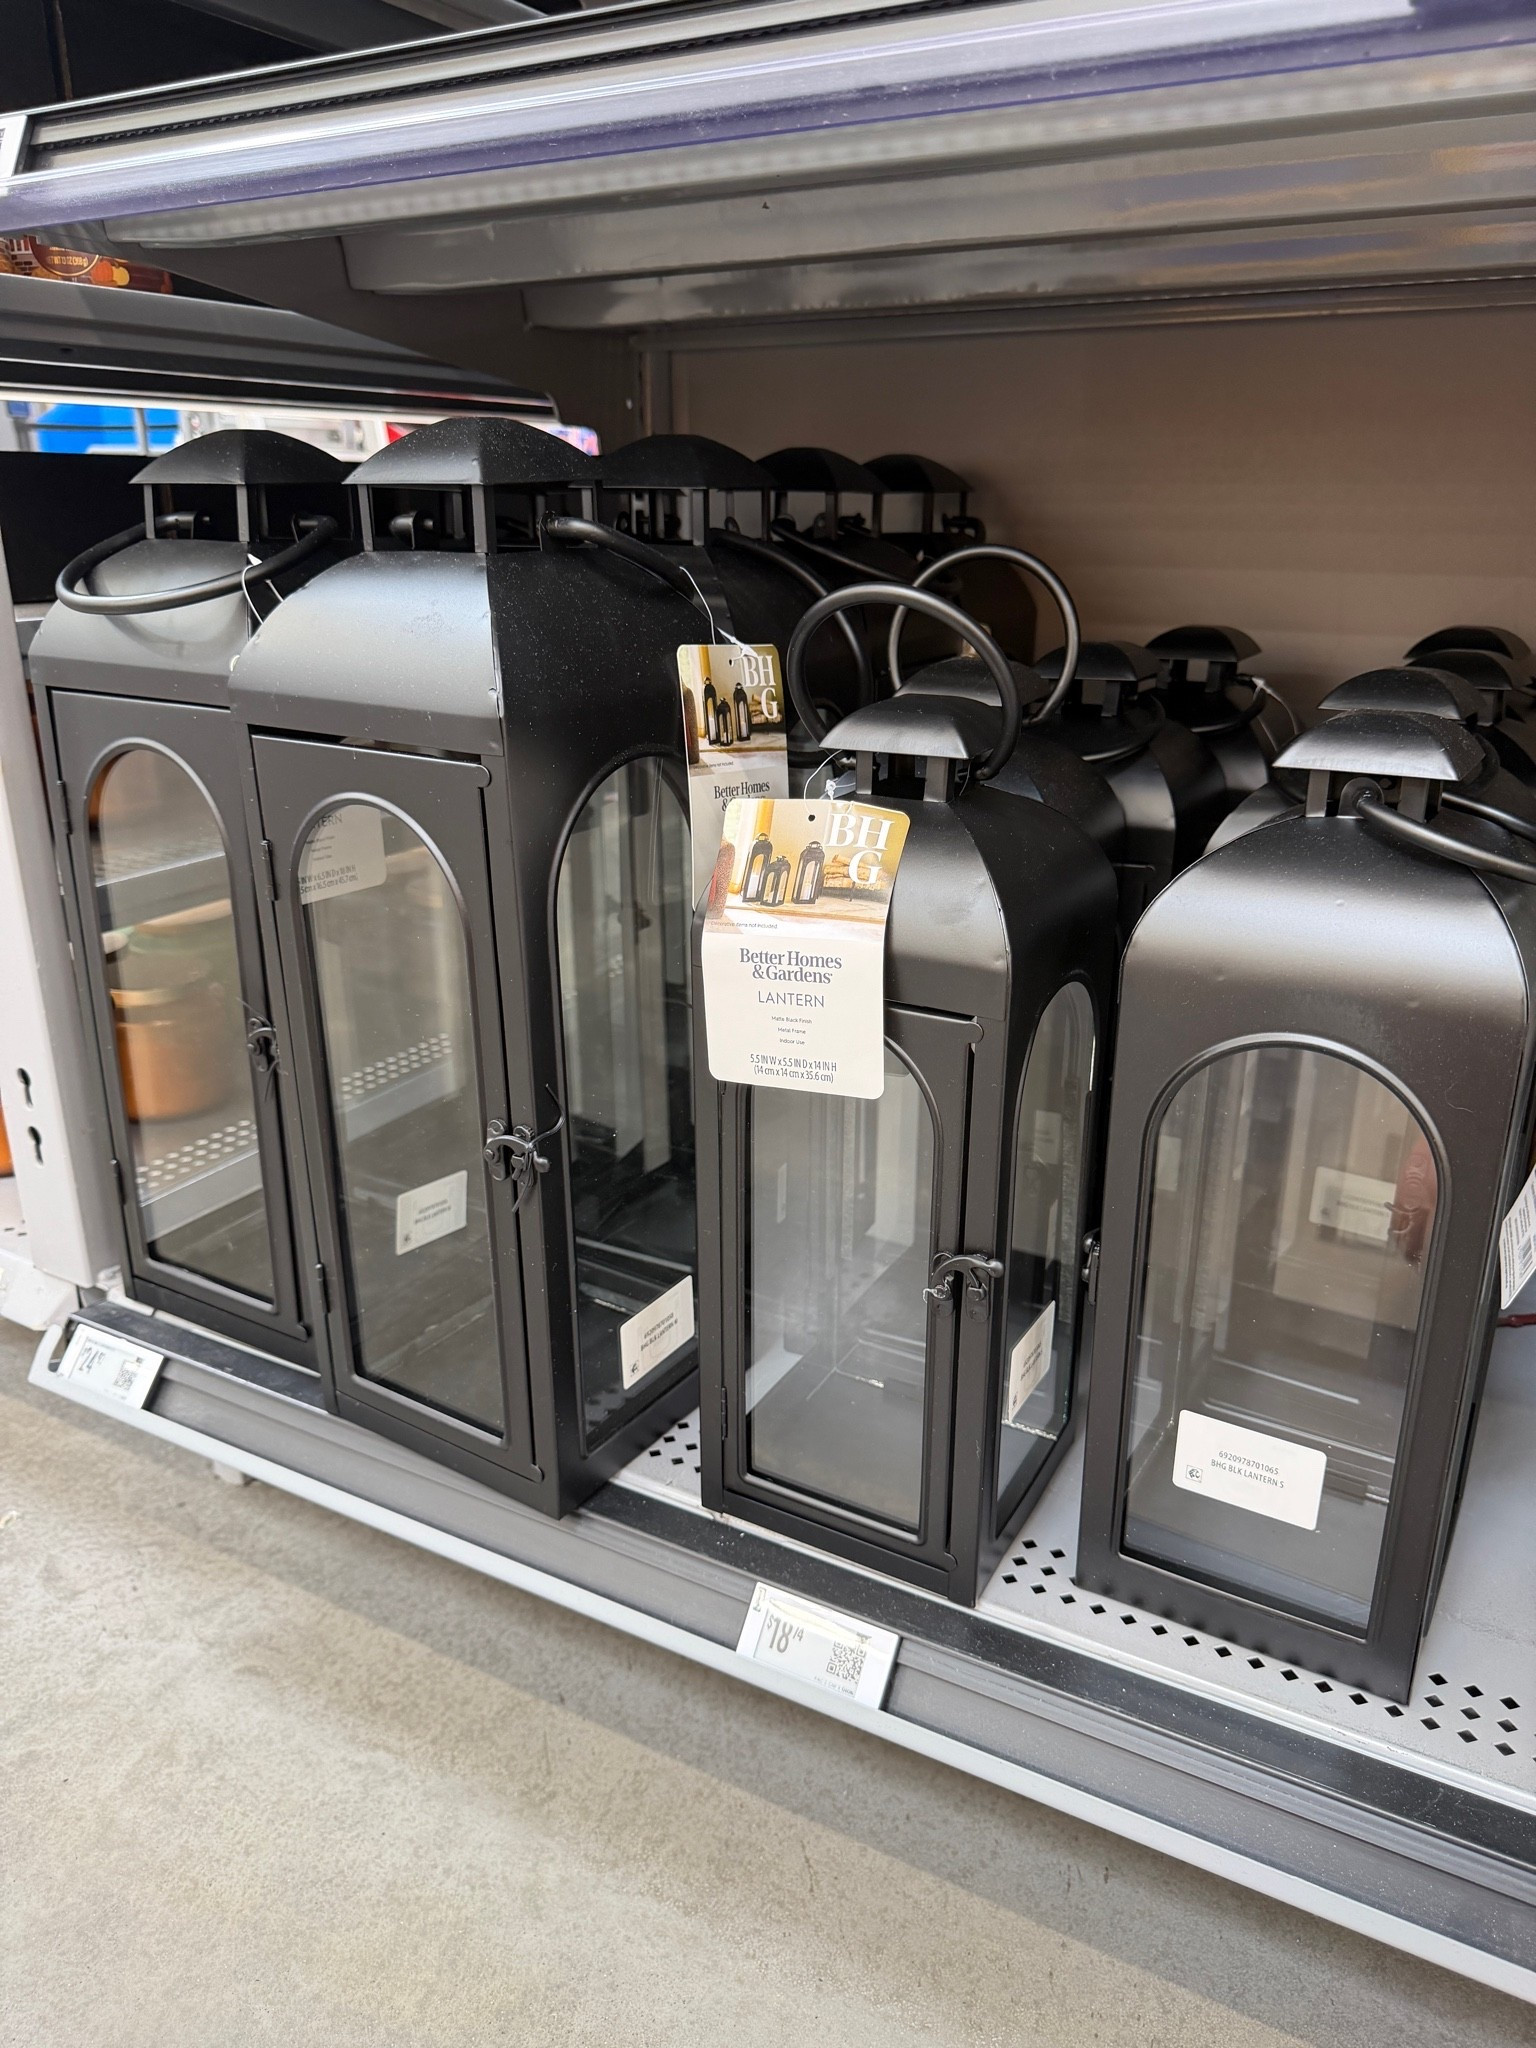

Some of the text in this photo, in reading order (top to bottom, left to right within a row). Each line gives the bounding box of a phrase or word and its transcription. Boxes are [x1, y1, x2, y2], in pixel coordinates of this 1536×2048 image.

[742, 655, 776, 687] BH
[761, 687, 778, 719] G
[714, 781, 770, 799] Better Homes
[827, 813, 894, 851] BH
[848, 850, 883, 885] G
[740, 948, 842, 969] Better Homes
[758, 990, 824, 1008] LANTERN
[754, 1065, 763, 1075] (14
[765, 1067, 774, 1076] cm
[781, 1068, 788, 1077] 14
[806, 1071, 819, 1080] 35.6
[821, 1073, 834, 1084] cm)
[761, 1055, 768, 1064] IN
[769, 1056, 776, 1065] W
[778, 1058, 782, 1066] x
[783, 1057, 792, 1067] 5.5
[794, 1058, 801, 1068] IN
[803, 1059, 807, 1069] D
[814, 1061, 821, 1070] 14
[823, 1061, 830, 1071] IN
[832, 1062, 837, 1072] H
[1211, 1459, 1284, 1489] BHG BLK LANTERN S
[1219, 1451, 1279, 1475] 6920978701065
